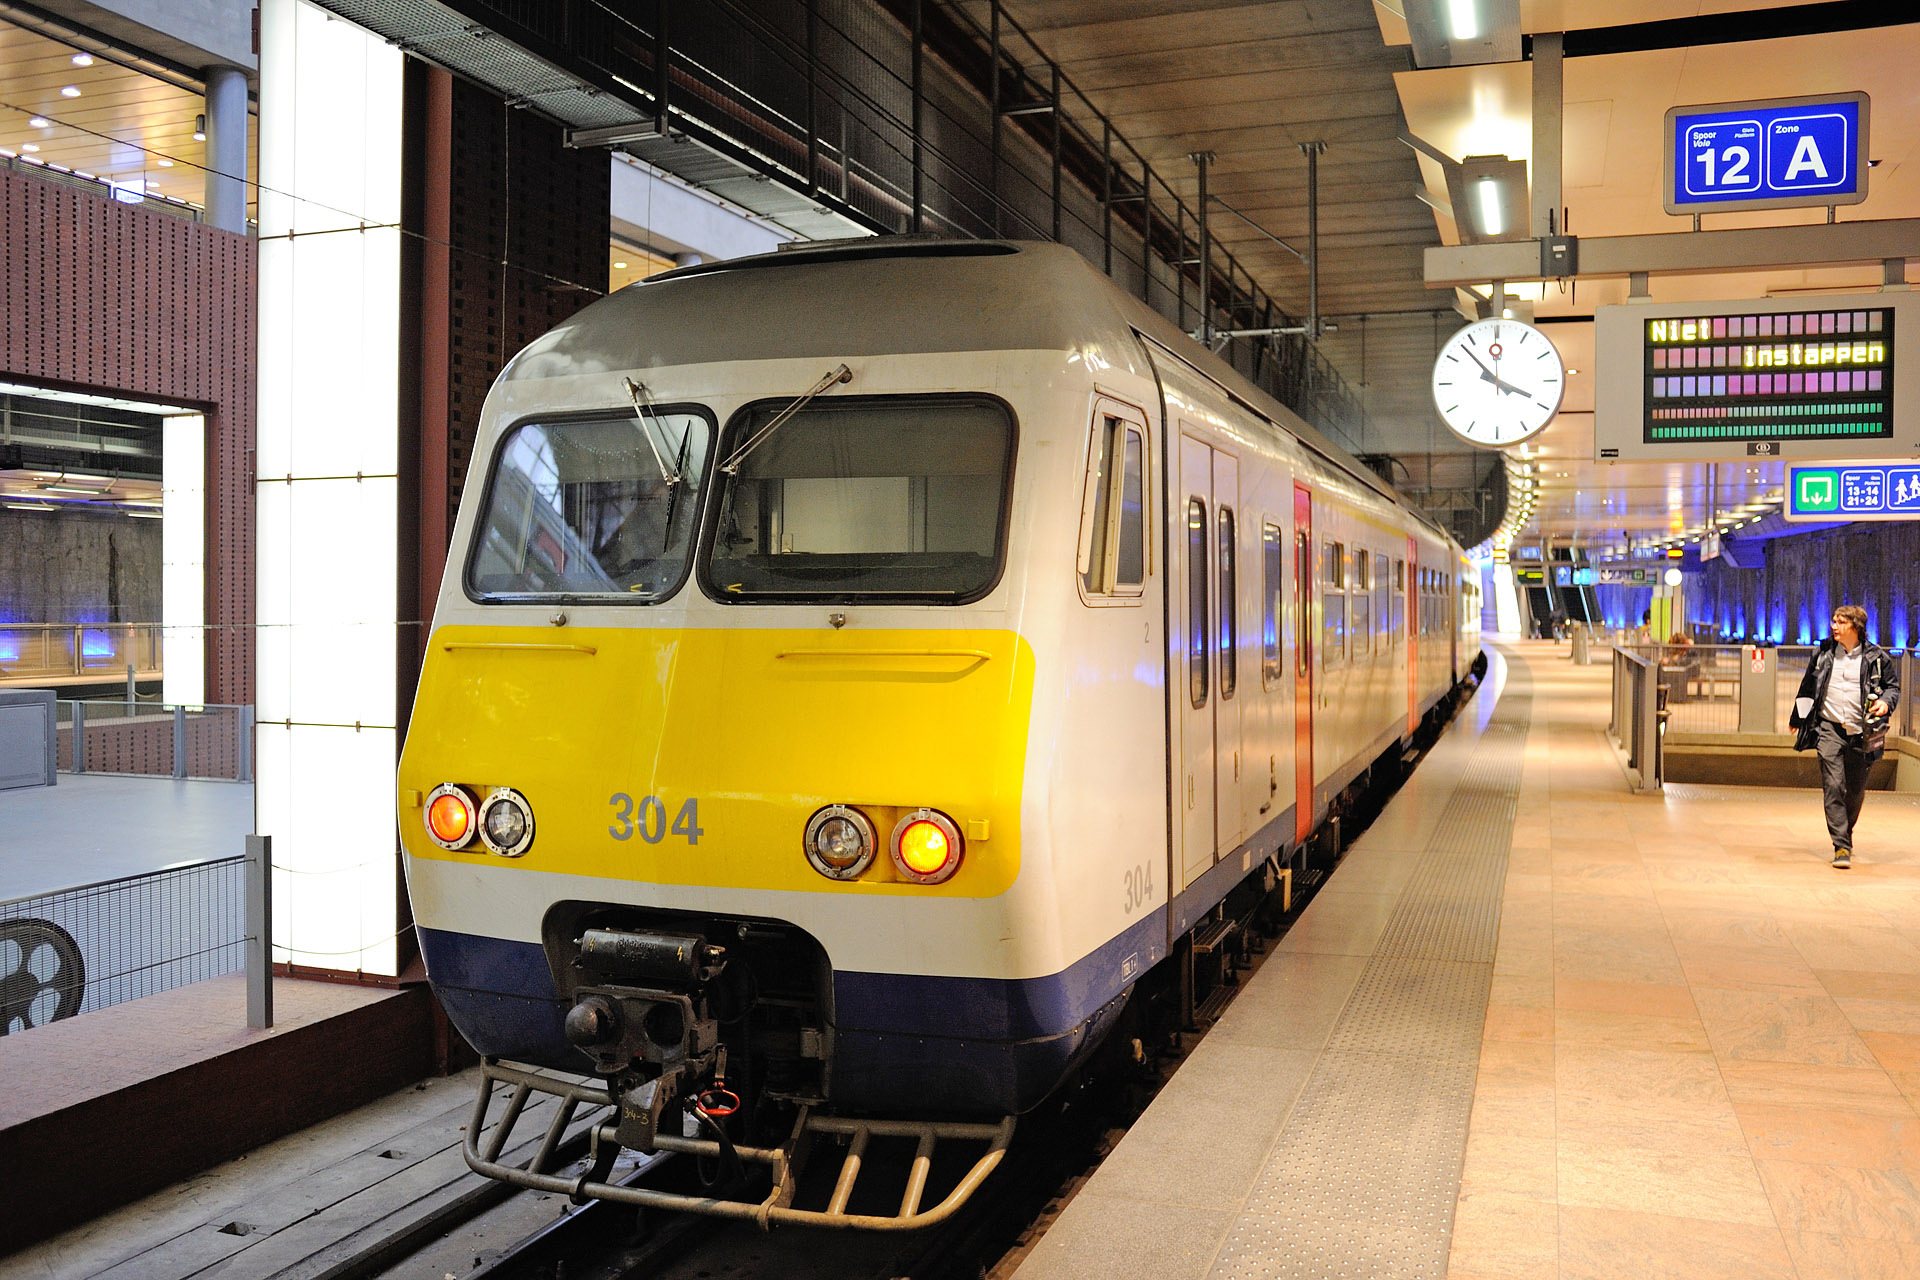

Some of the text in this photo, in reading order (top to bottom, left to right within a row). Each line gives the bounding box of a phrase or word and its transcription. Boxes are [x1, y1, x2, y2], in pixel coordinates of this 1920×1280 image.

[1693, 131, 1717, 140] Spoor
[1775, 125, 1800, 134] Zone
[1693, 140, 1711, 148] Voie
[1696, 146, 1750, 186] 12
[1784, 135, 1829, 180] A
[1652, 318, 1709, 342] Niet
[1744, 344, 1884, 368] instappen
[1144, 621, 1150, 643] 2
[608, 792, 704, 846] 304
[1123, 859, 1153, 914] 304
